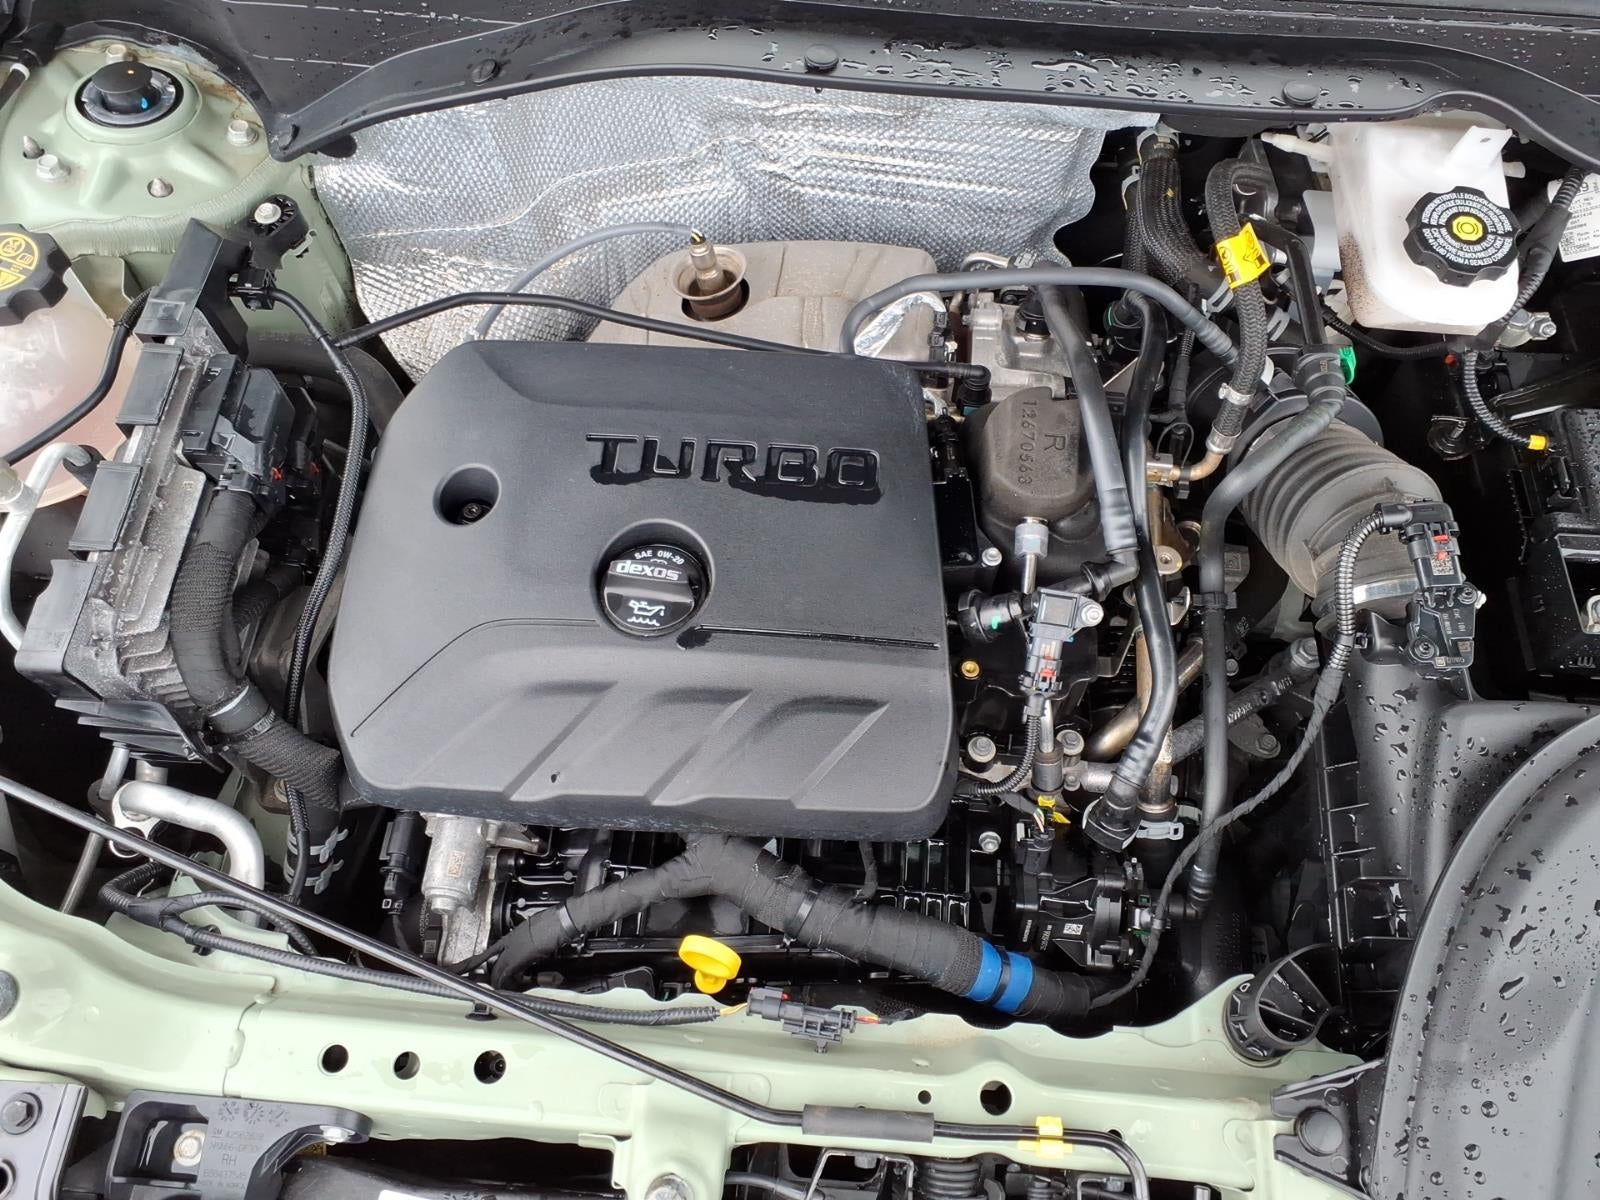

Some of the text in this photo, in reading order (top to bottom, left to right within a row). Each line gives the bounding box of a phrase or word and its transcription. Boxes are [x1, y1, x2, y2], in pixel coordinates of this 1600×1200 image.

[1430, 242, 1447, 257] FLUID
[1444, 252, 1464, 264] FROM
[1044, 433, 1066, 451] R
[586, 434, 880, 491] TURBO
[634, 549, 685, 565] SAE 0W-20
[616, 560, 682, 581] dexos
